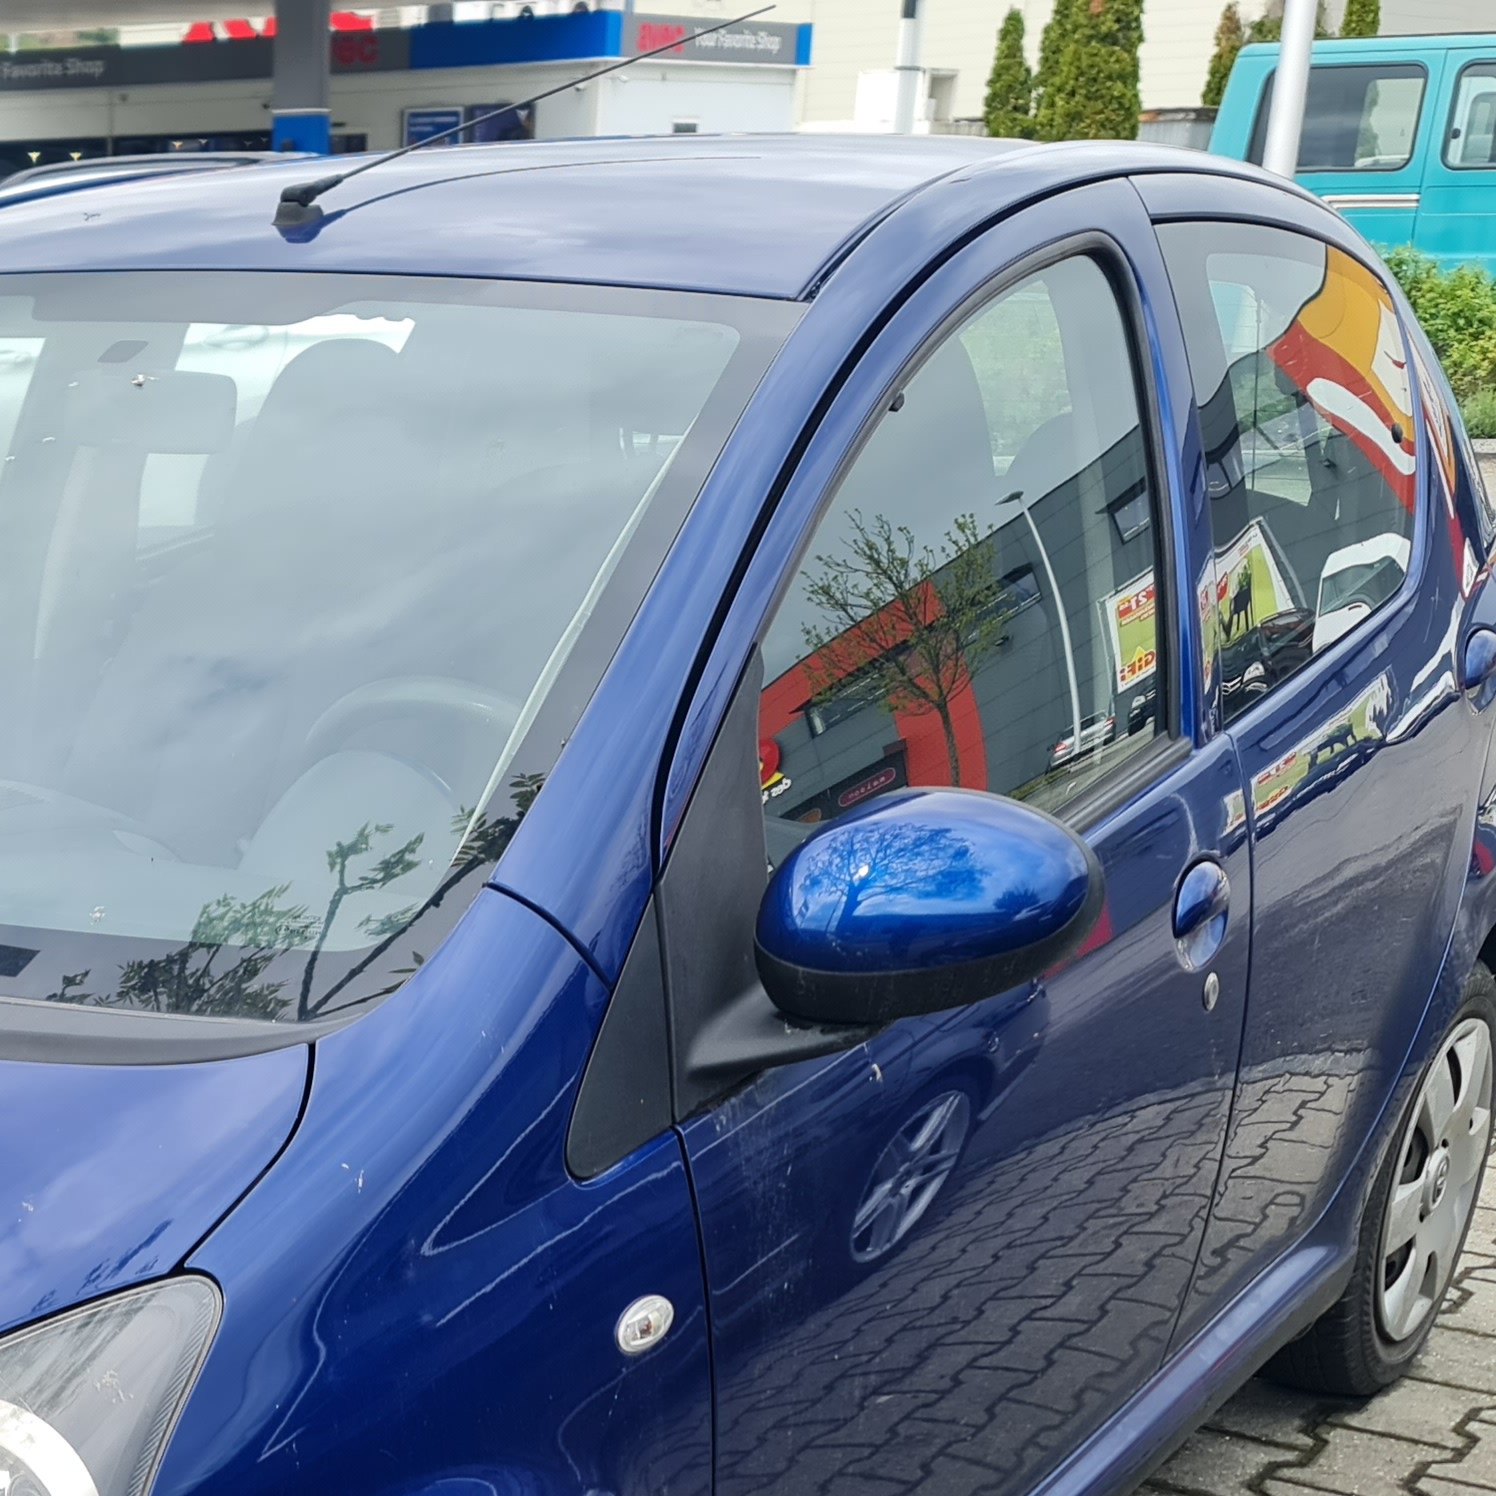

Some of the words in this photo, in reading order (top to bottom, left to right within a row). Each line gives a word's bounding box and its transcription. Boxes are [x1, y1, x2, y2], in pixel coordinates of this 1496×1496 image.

[757, 31, 782, 54] Shop
[2, 60, 63, 79] Favorite
[64, 57, 105, 79] Shop
